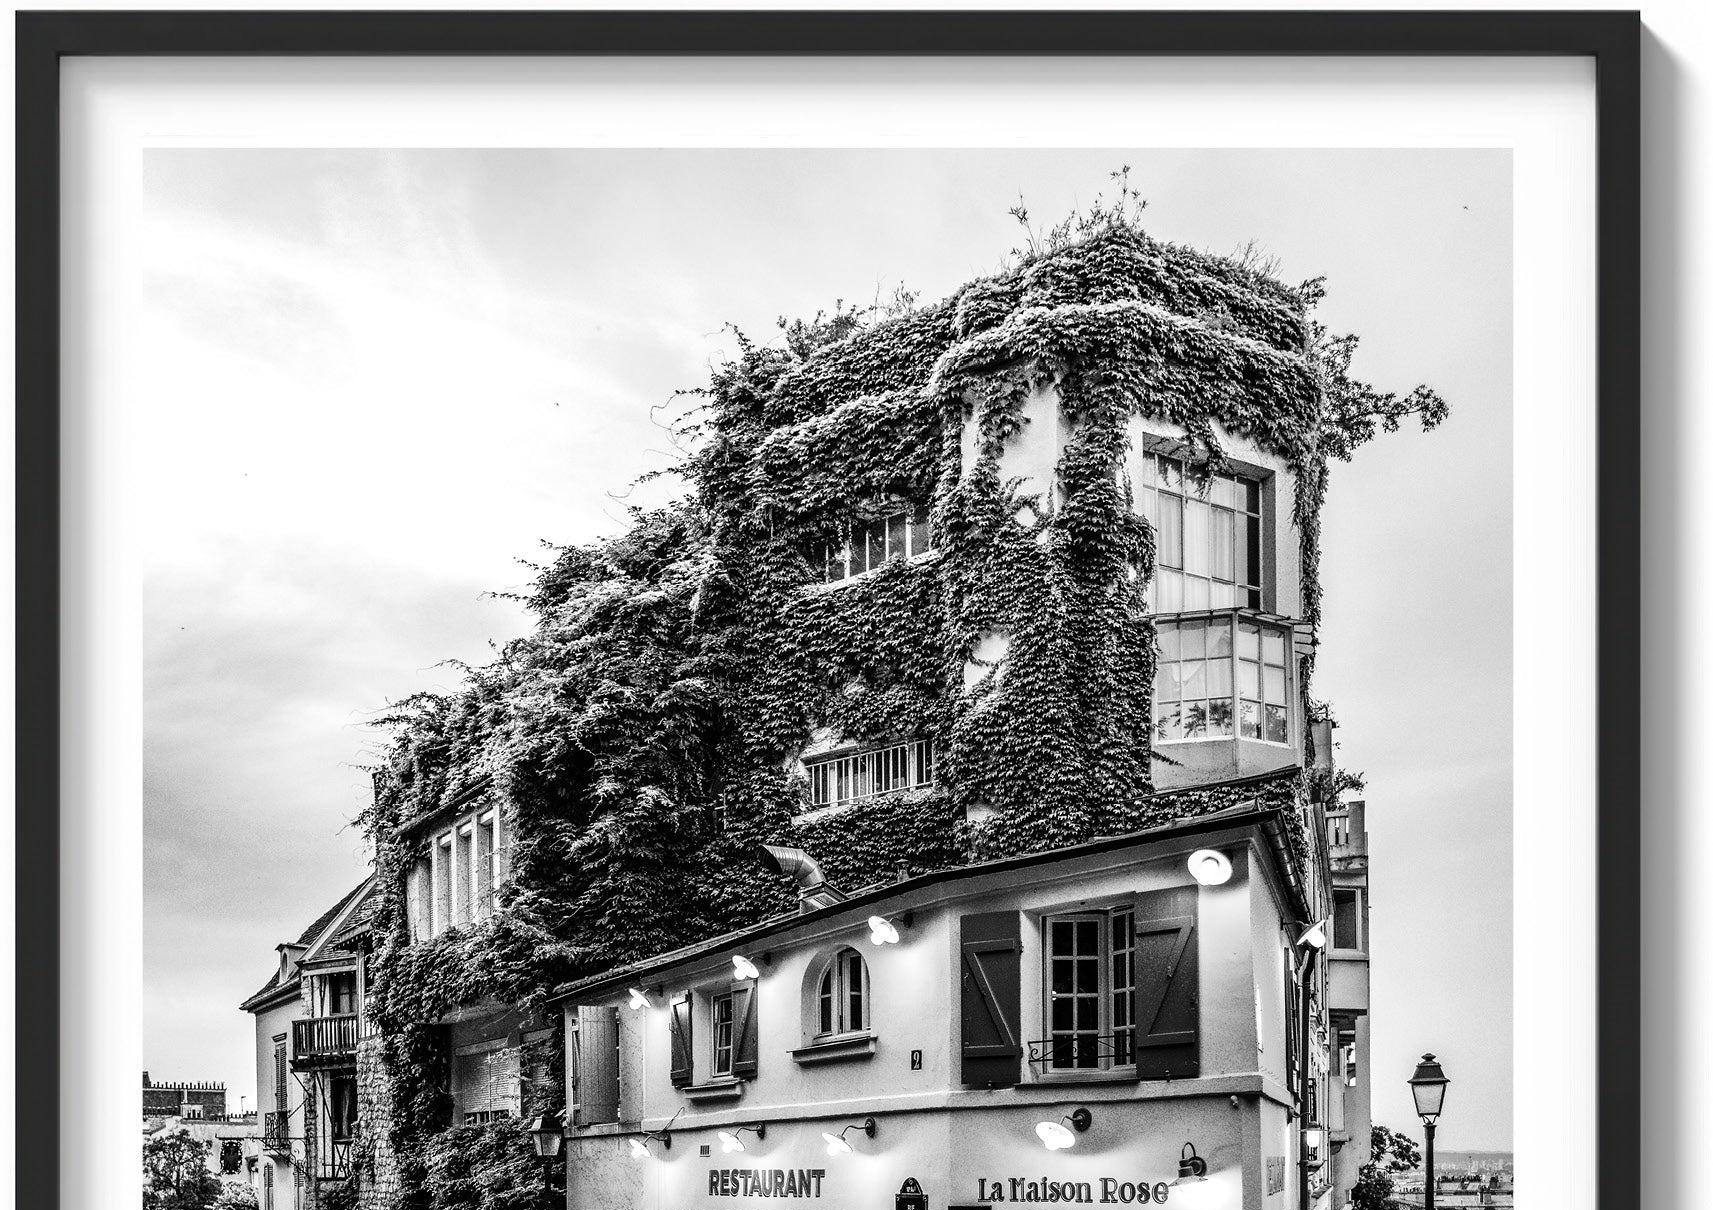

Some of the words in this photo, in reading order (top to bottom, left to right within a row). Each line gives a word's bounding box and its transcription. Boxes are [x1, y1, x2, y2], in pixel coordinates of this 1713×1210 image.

[708, 1168, 826, 1198] RESTAURANT
[977, 1177, 1005, 1203] La
[1008, 1176, 1094, 1204] Maison
[1099, 1177, 1169, 1205] Rose
